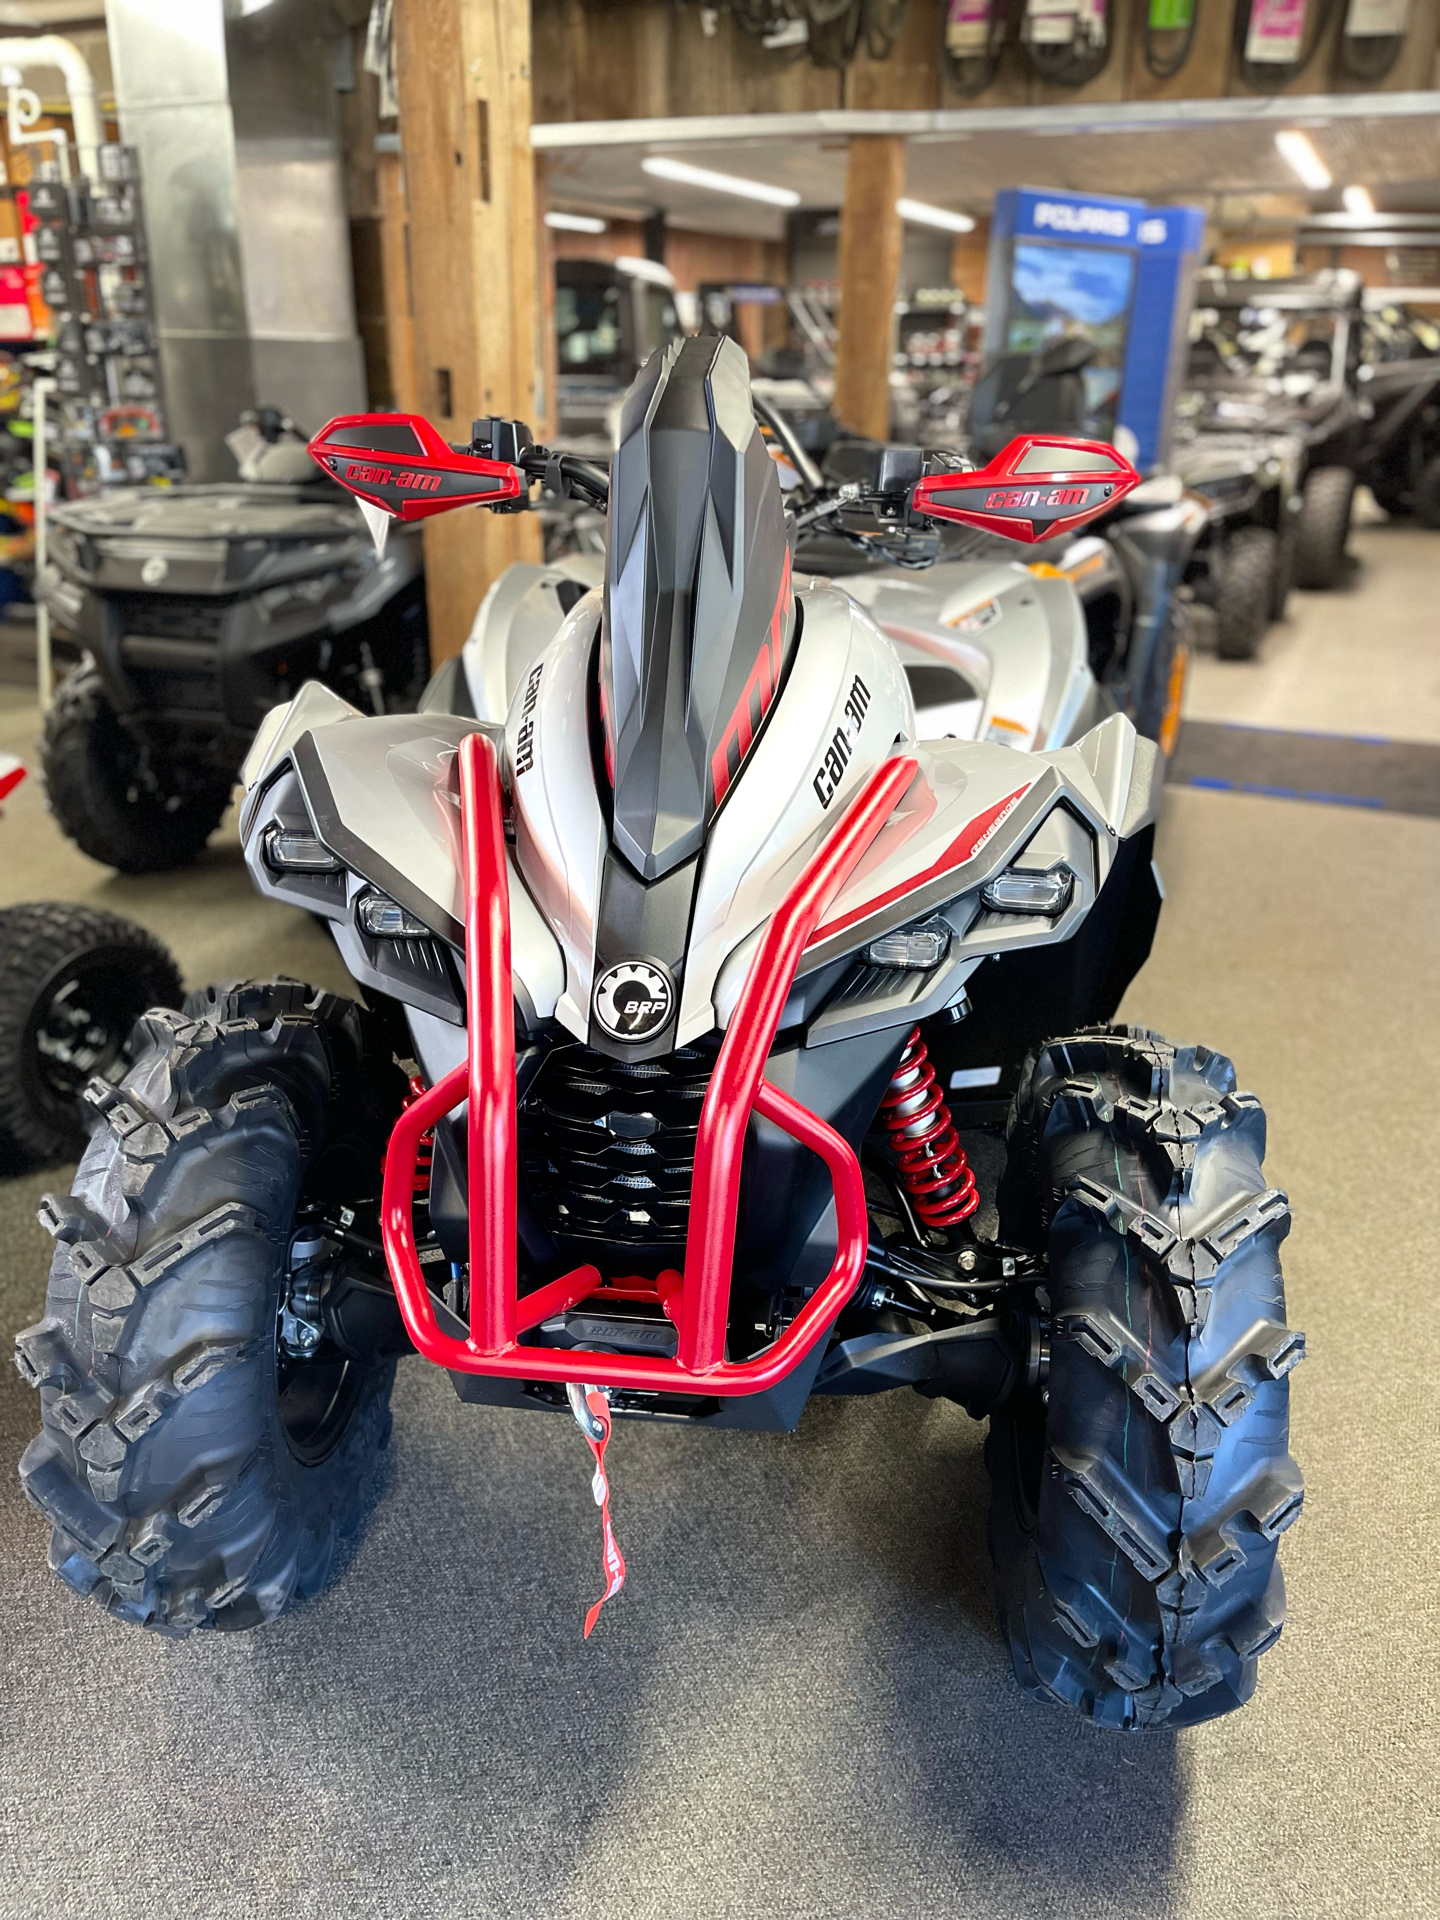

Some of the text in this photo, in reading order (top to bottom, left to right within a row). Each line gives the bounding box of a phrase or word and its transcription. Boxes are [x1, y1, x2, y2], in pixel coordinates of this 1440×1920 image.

[345, 463, 442, 491] can-am
[985, 488, 1090, 509] can-am
[970, 796, 1018, 857] RENEGADE
[624, 1000, 666, 1030] BRP
